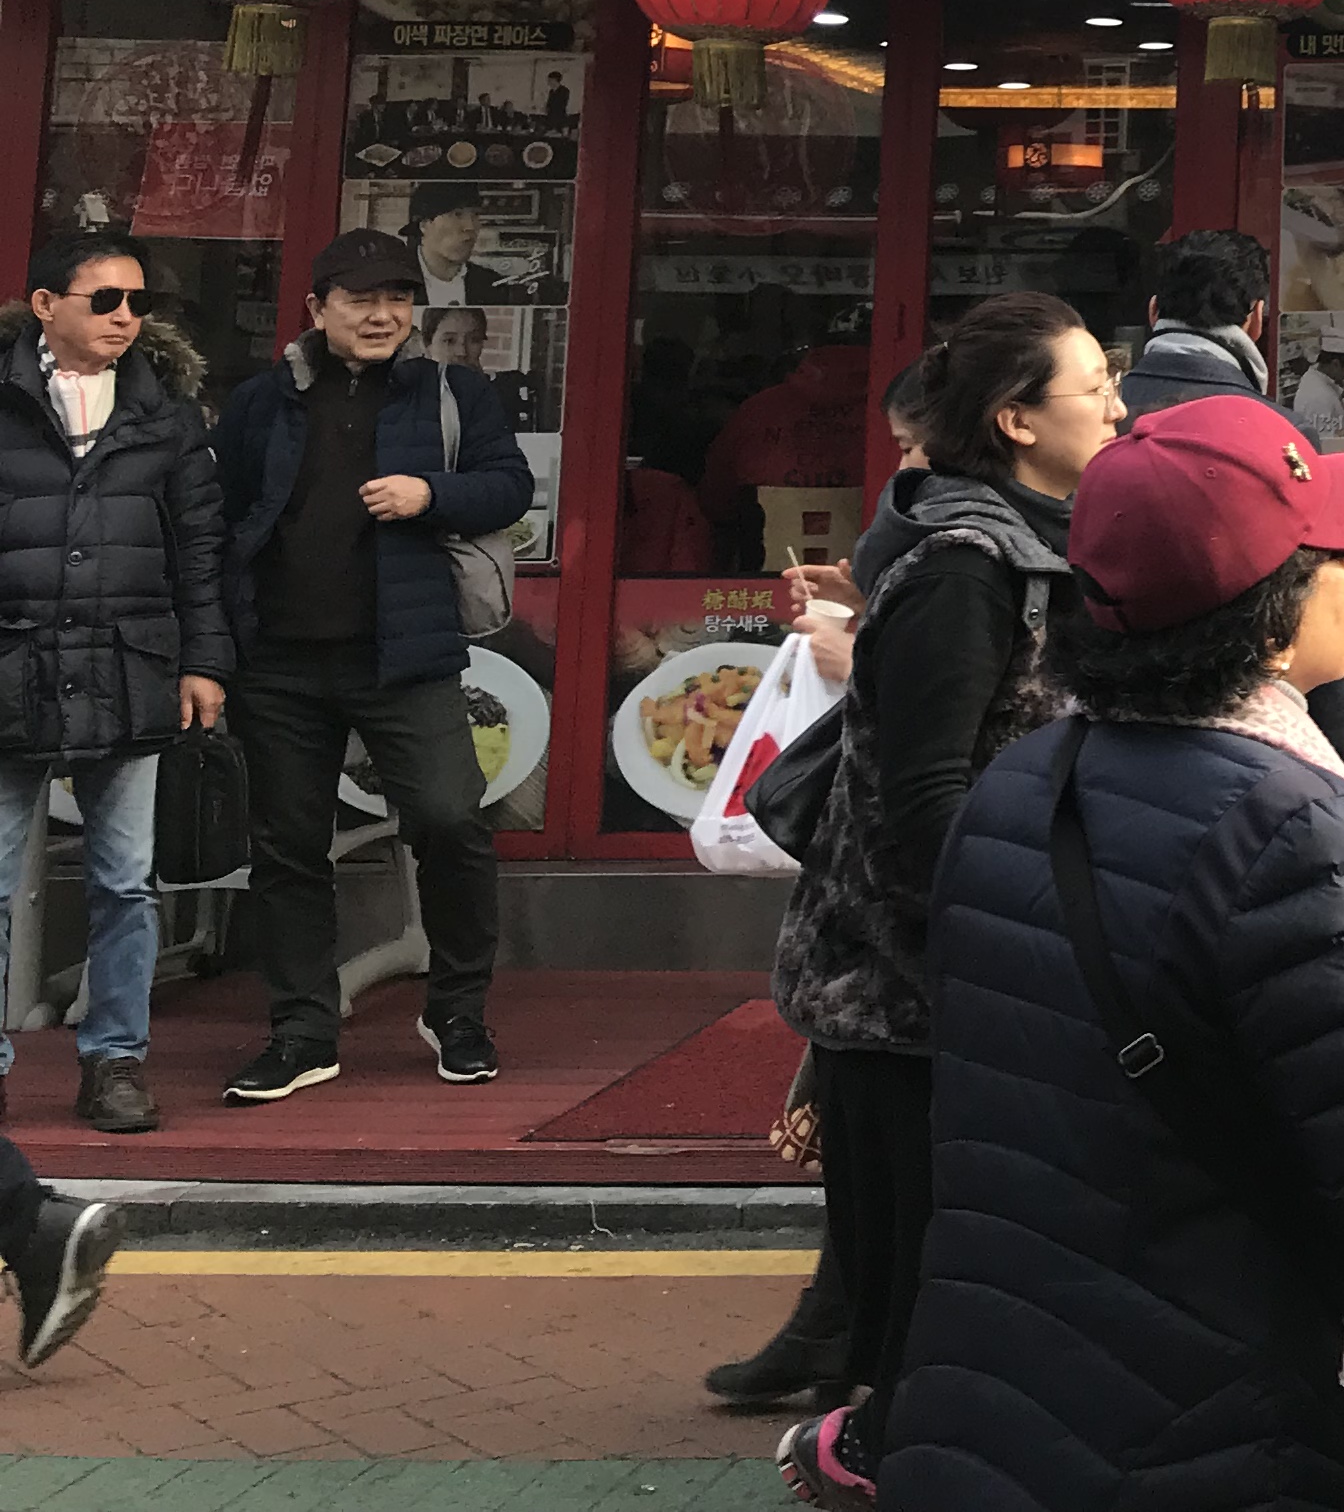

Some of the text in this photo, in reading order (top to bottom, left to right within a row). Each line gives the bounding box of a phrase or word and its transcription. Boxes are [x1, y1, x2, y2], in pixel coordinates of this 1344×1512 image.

[393, 24, 429, 46] 이색
[493, 25, 549, 46] 레이스
[1299, 34, 1316, 56] 내
[701, 587, 776, 611] 糖醋蝦
[704, 614, 770, 633] 탕수새우
